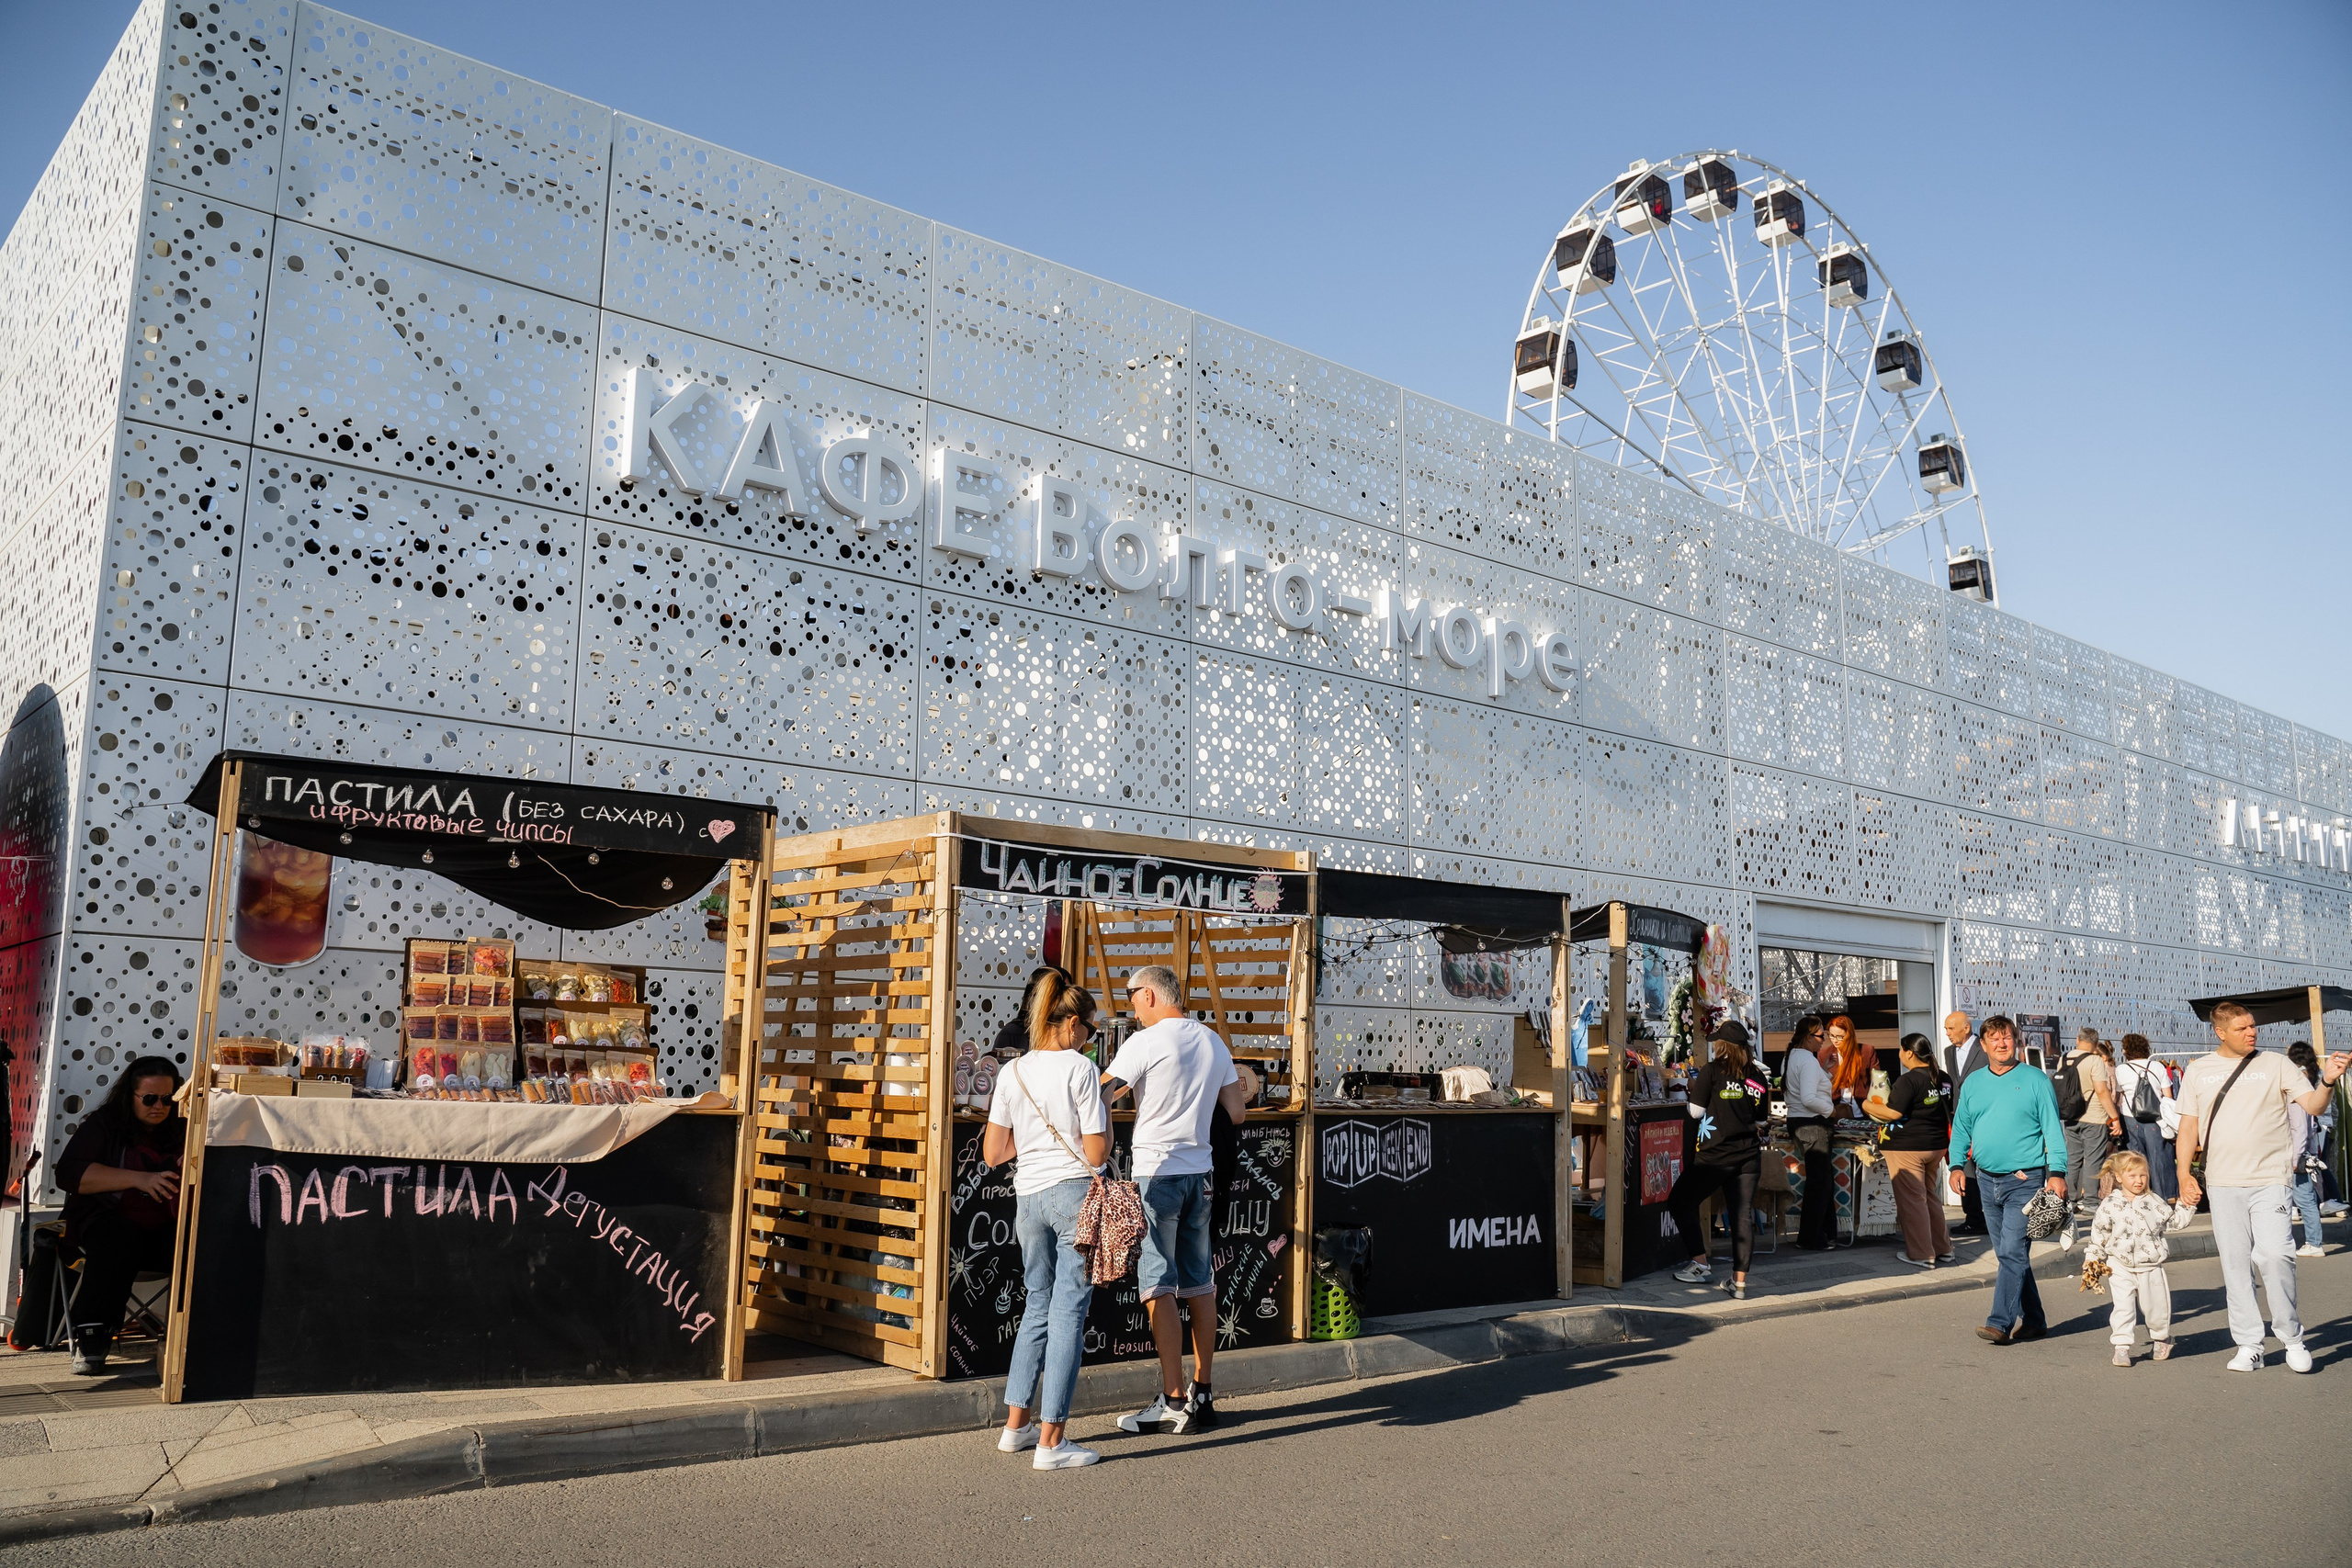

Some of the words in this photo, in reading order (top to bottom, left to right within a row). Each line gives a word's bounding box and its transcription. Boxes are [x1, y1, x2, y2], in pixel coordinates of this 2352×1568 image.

[620, 366, 994, 558] КАФЕ
[1032, 471, 1579, 698] Волга-море
[265, 776, 477, 817] ПАСТИЛА
[2226, 1072, 2267, 1081] ILOR
[1237, 1142, 1283, 1201] РЯДИСЬ
[1327, 1131, 1349, 1177] POP
[1354, 1131, 1376, 1177] UP
[1407, 1126, 1429, 1170] END
[249, 1161, 518, 1228] ПАСТИЛА
[950, 1160, 996, 1215] ВЗБО
[981, 1184, 1016, 1200] ПРОС
[1449, 1213, 1542, 1249] ИМЕНА
[964, 1257, 1000, 1307] ПУЭР
[997, 1314, 1022, 1344] ГАБ
[1114, 1337, 1159, 1356] teasun.
